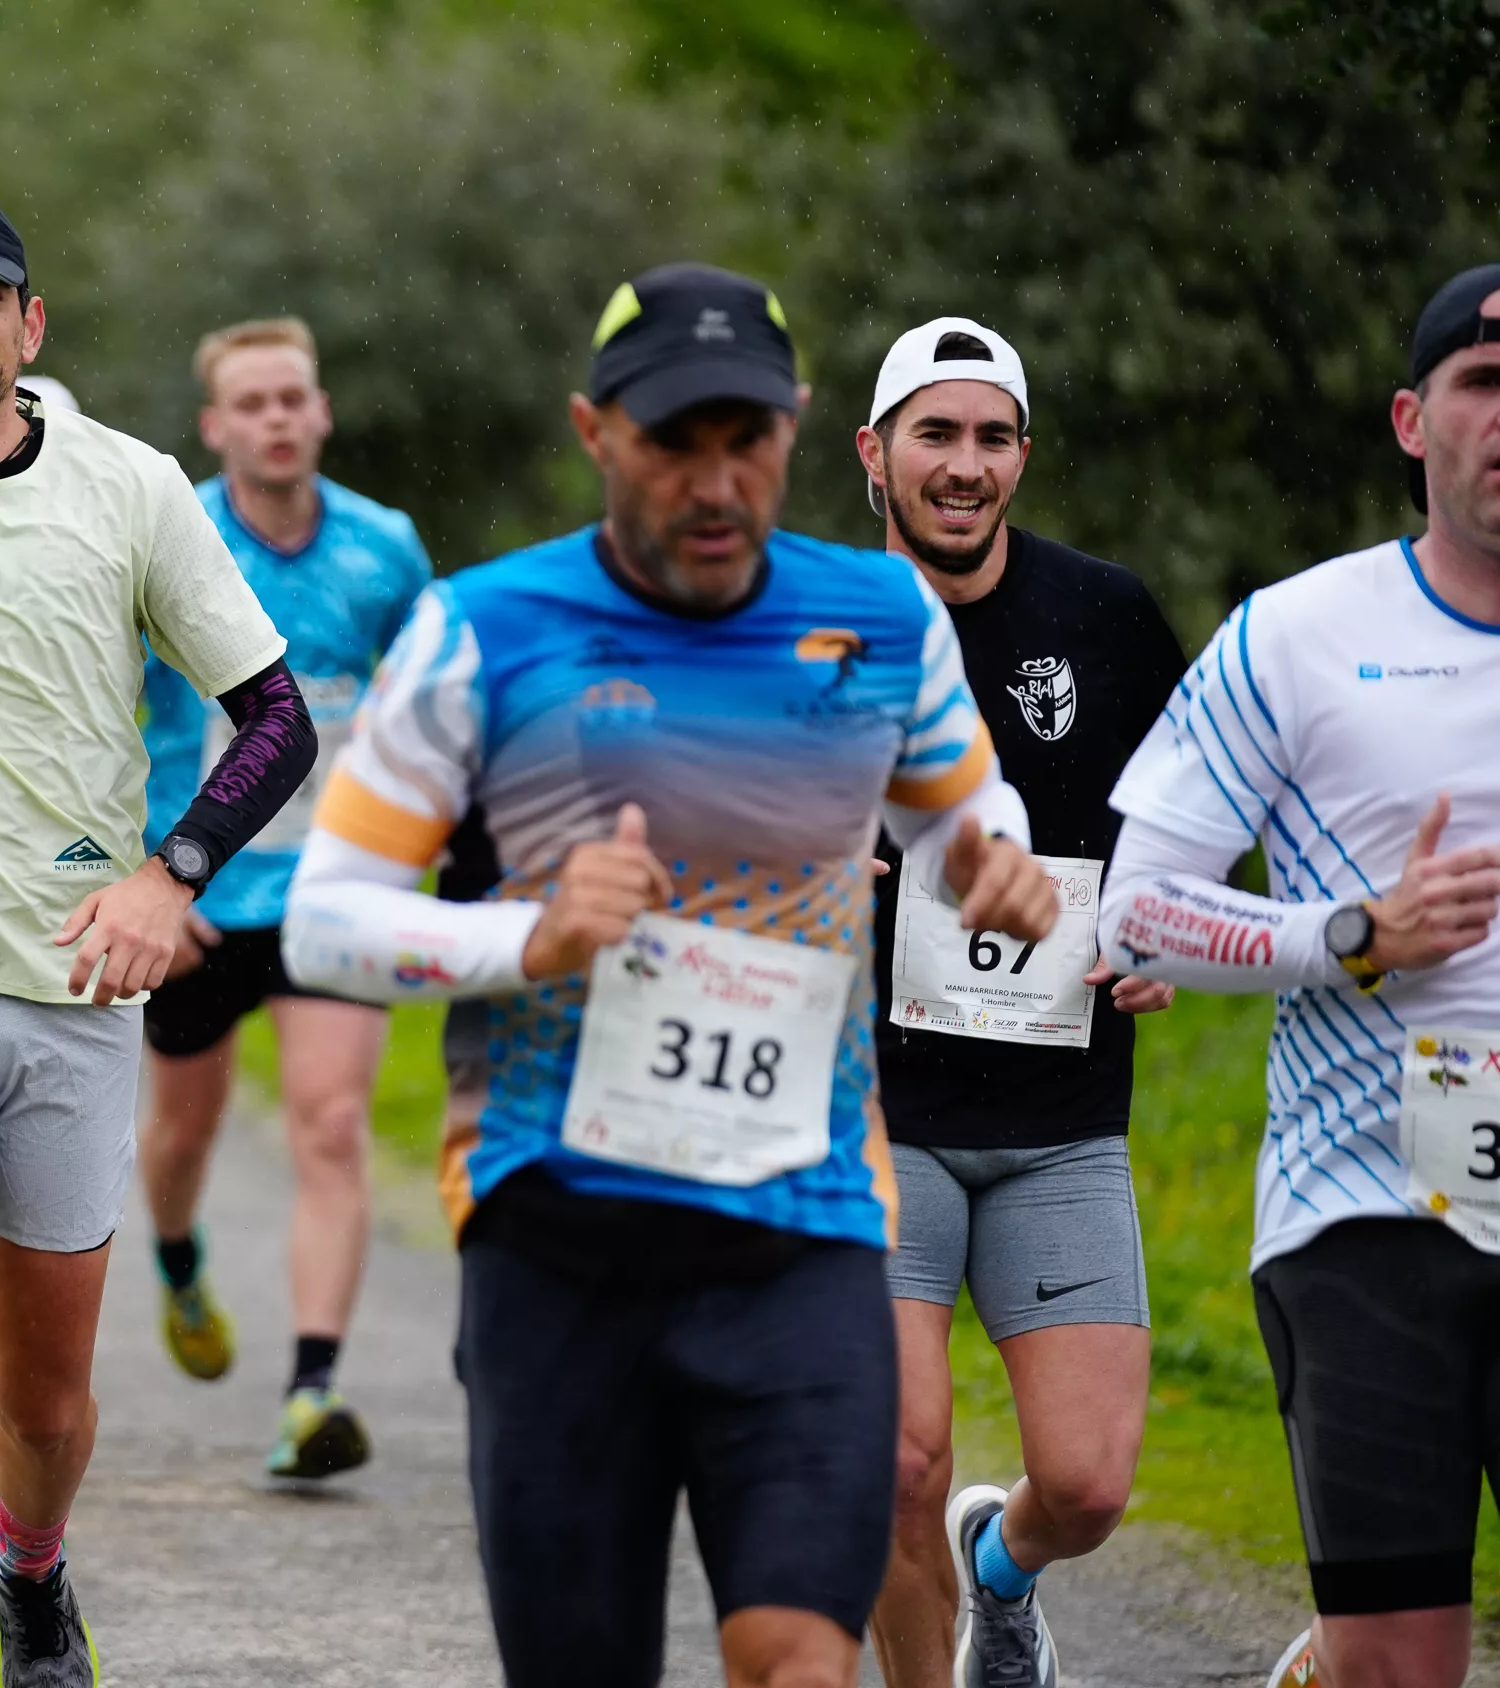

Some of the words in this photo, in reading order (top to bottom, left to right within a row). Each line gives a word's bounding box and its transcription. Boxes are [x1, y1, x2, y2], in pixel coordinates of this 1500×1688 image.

[82, 862, 112, 870] TRAIL
[945, 984, 968, 992] MANU
[969, 987, 1010, 997] BARRILERO
[1010, 991, 1054, 1001] MOHEDANO
[649, 1017, 783, 1101] 318
